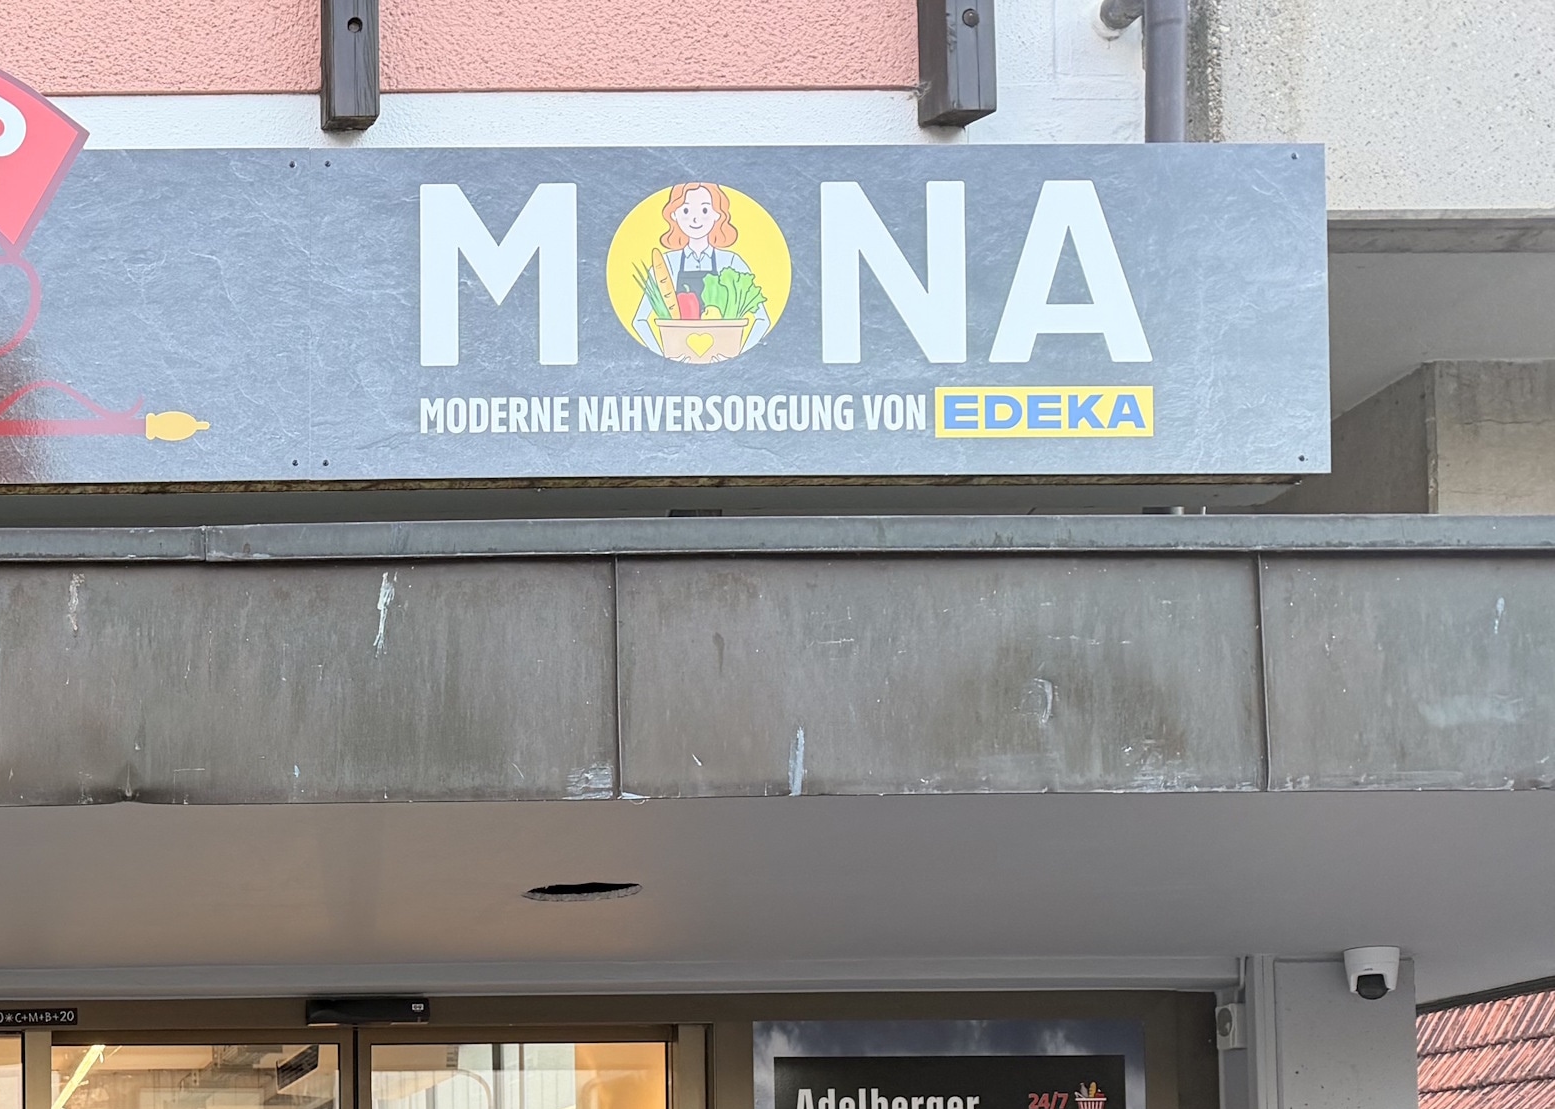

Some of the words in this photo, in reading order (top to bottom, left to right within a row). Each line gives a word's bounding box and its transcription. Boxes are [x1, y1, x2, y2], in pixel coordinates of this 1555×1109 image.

[419, 396, 571, 434] MODERNE
[578, 394, 855, 433] NAHVERSORGUNG
[862, 392, 928, 431] VON
[942, 393, 1147, 431] EDEKA
